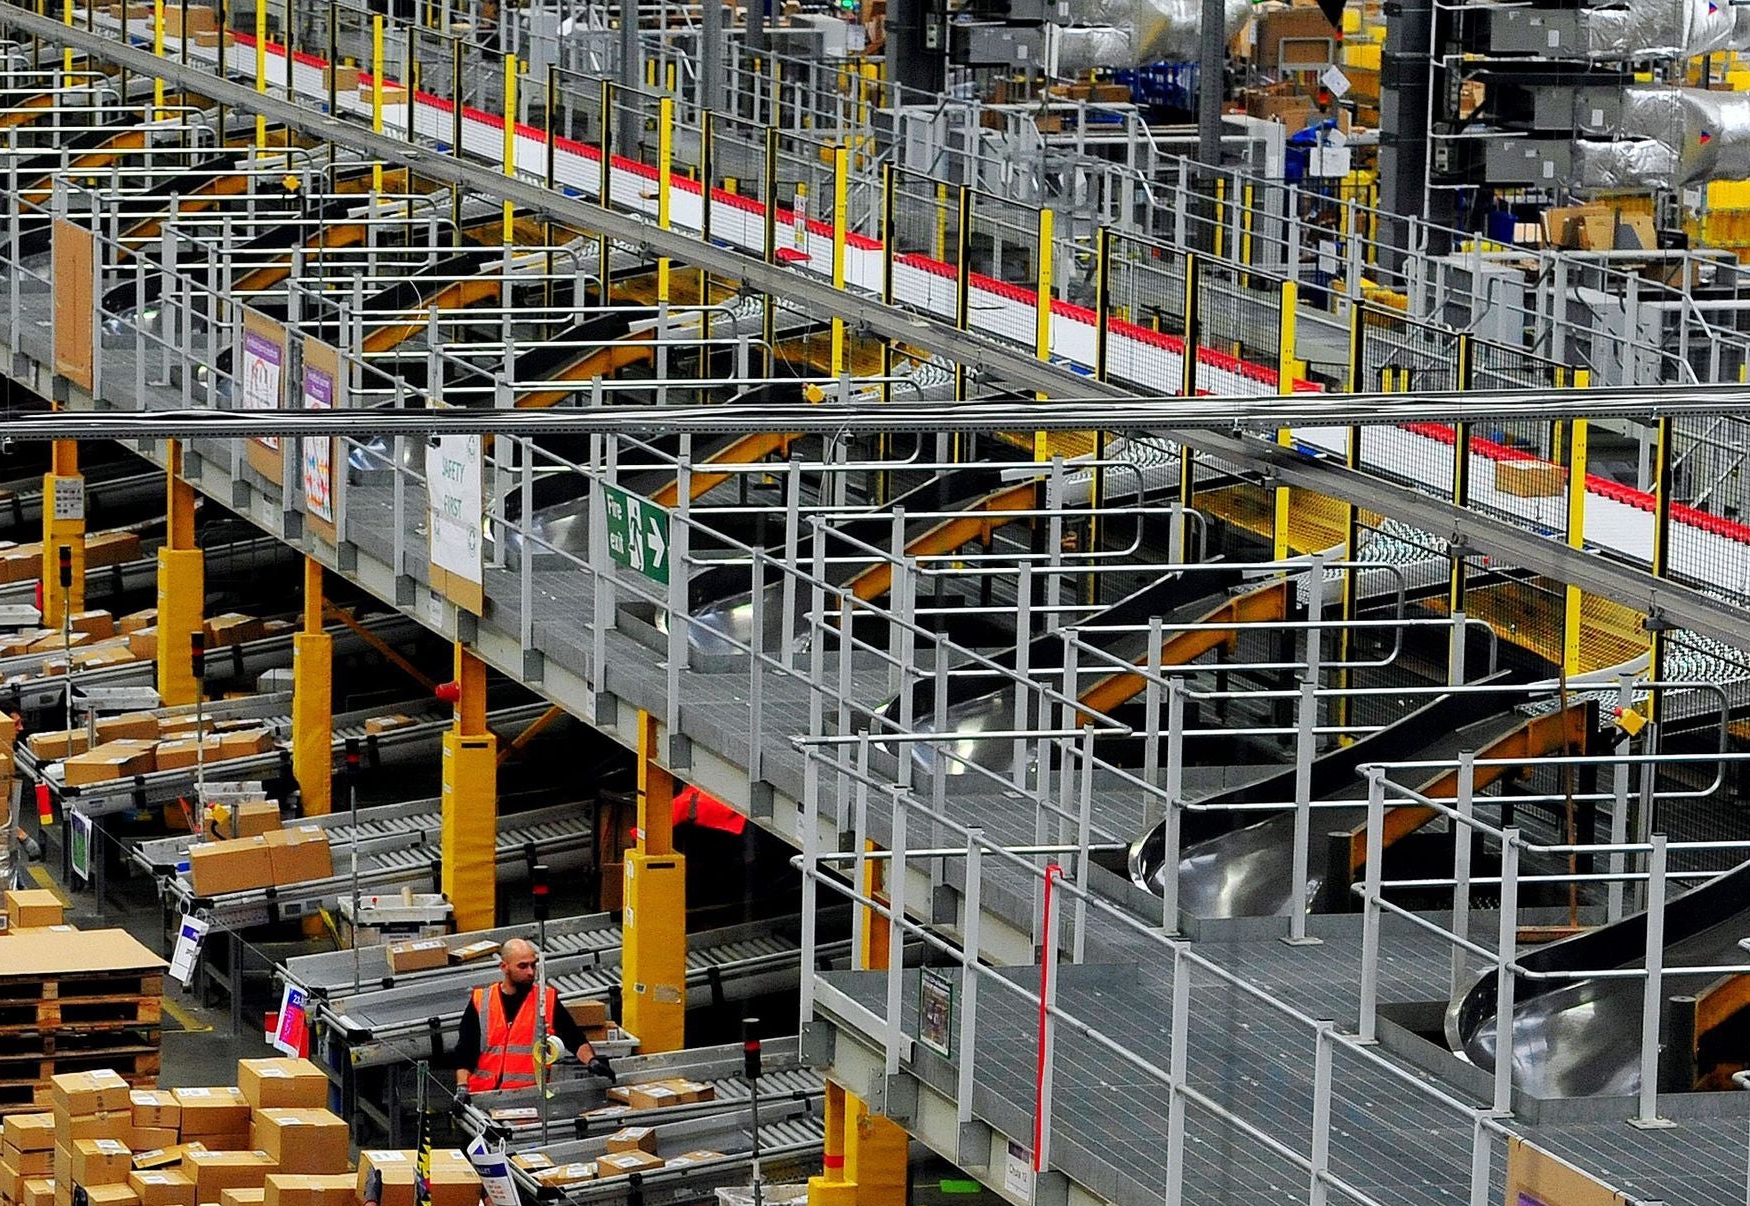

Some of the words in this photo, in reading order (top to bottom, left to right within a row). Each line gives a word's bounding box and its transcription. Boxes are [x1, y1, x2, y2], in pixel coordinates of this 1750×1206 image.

[441, 455, 466, 484] SAFETY
[444, 494, 463, 519] FIRST
[606, 493, 623, 520] Fire
[610, 531, 625, 555] exit
